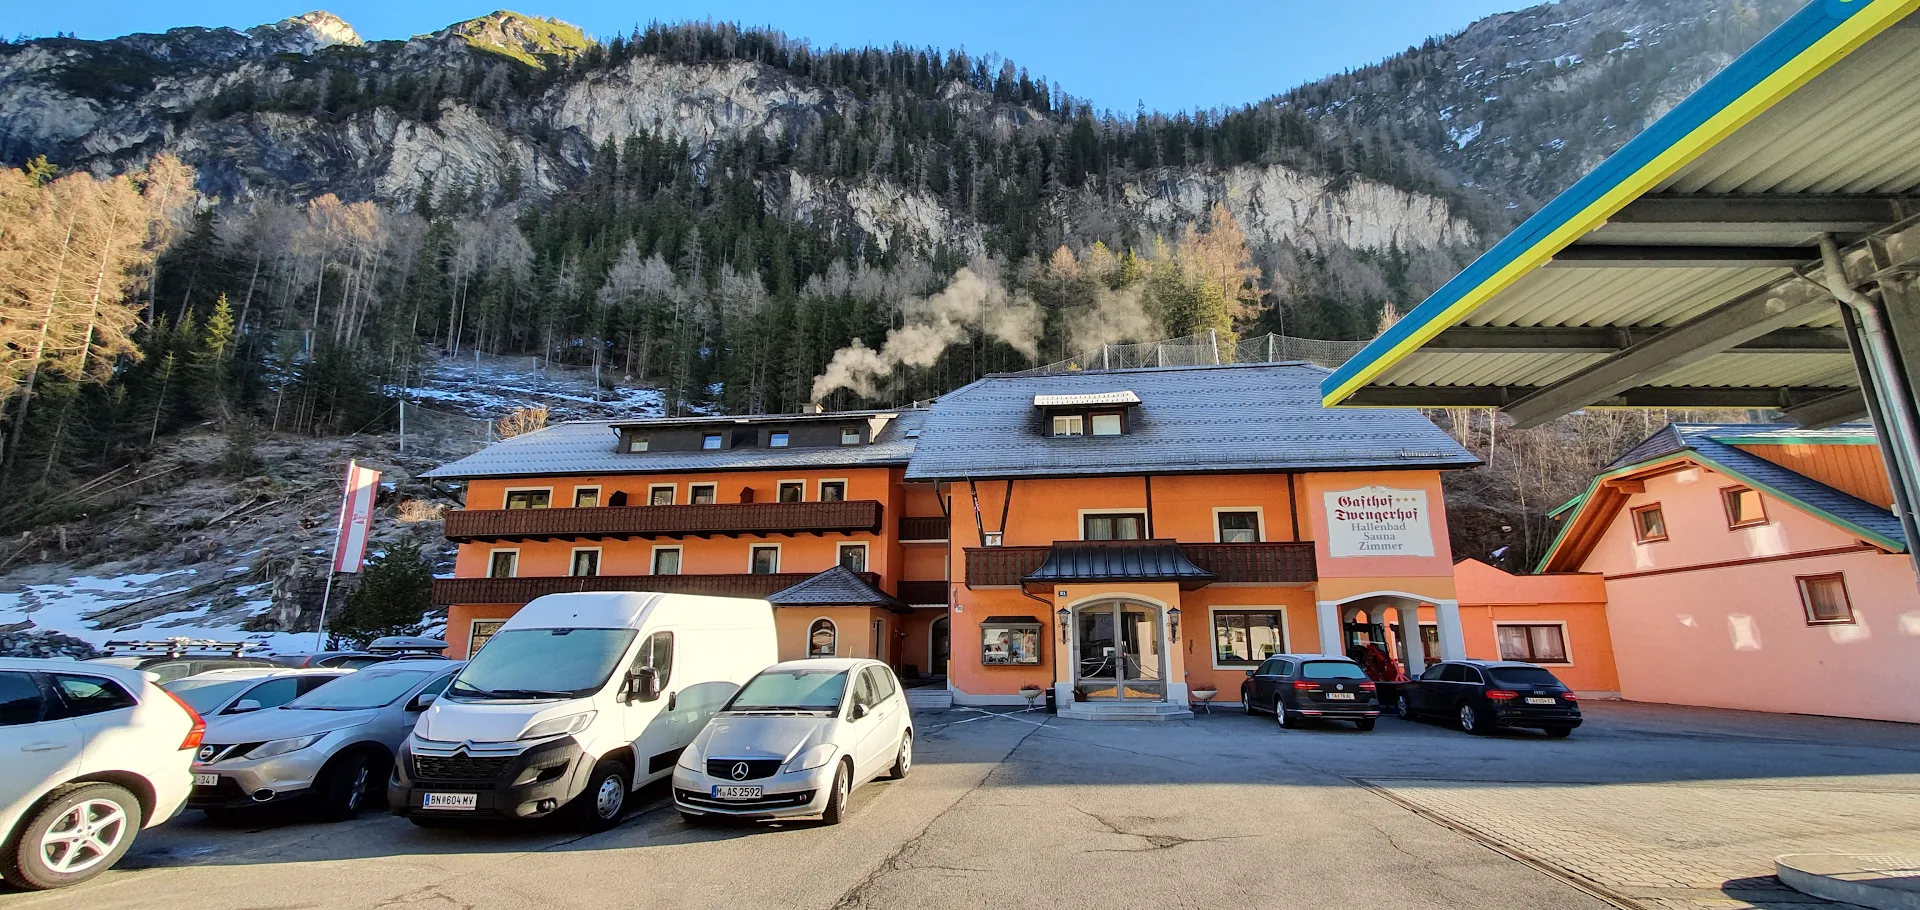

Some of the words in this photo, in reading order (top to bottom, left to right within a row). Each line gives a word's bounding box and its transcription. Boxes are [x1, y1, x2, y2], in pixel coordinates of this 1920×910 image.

[1338, 495, 1393, 509] Gasthof
[1334, 508, 1418, 523] Twengerhof
[1351, 522, 1406, 532] Hallenbad
[1363, 532, 1396, 541] Sauna
[1358, 541, 1404, 551] Zimmer
[716, 787, 722, 796] M
[726, 787, 738, 797] AS
[739, 787, 760, 797] 2592
[431, 795, 442, 805] BN
[446, 795, 461, 805] 604
[463, 795, 474, 805] MV
